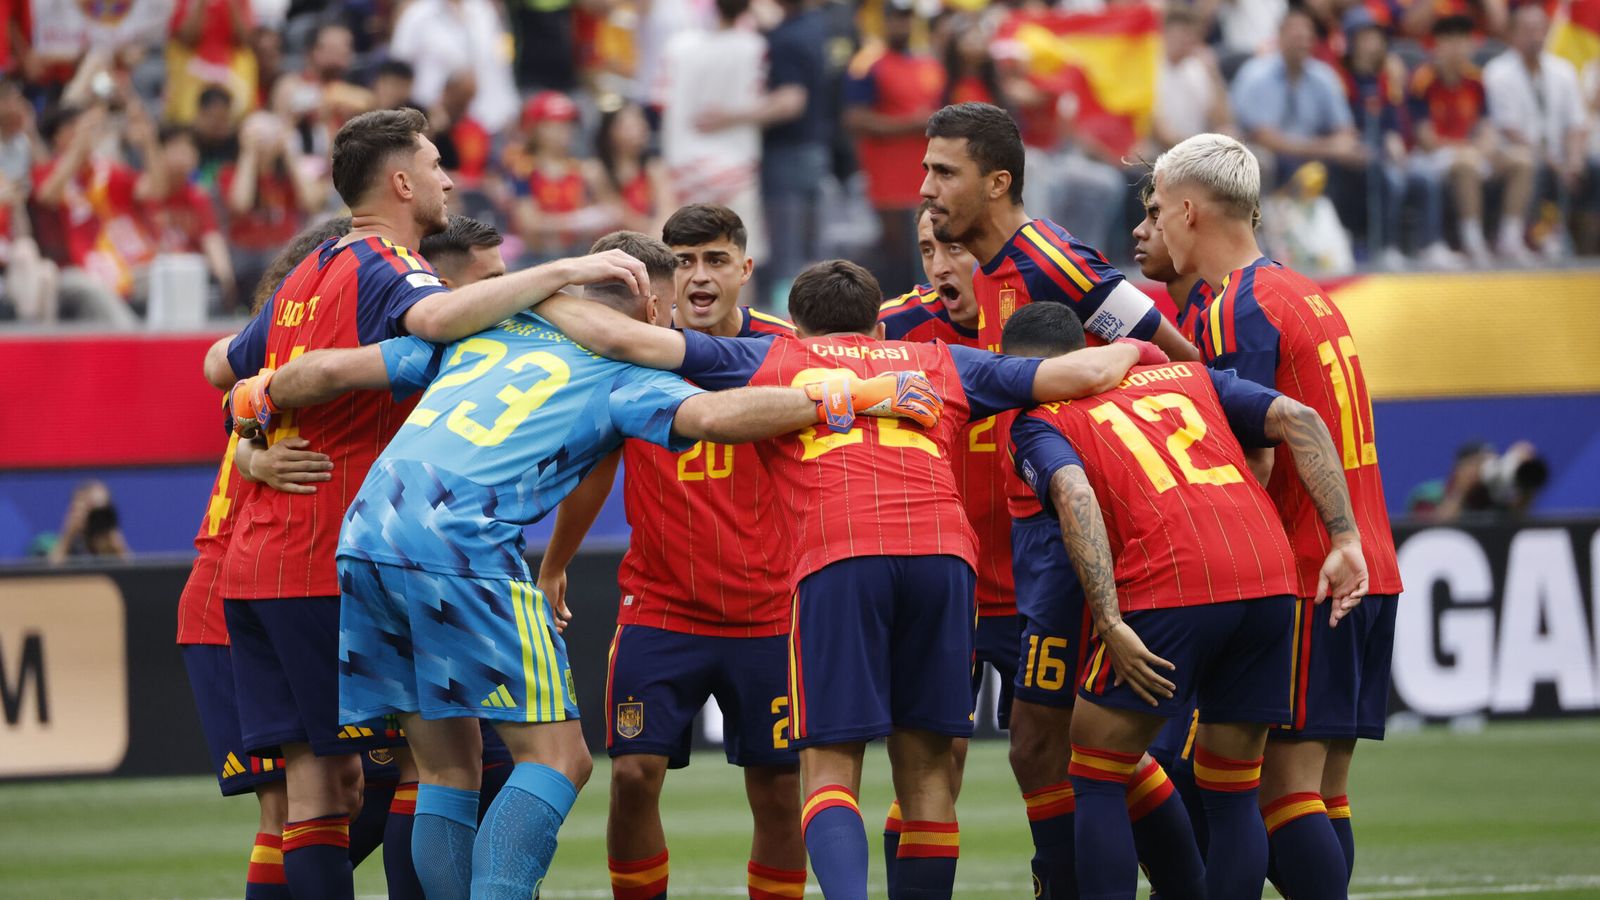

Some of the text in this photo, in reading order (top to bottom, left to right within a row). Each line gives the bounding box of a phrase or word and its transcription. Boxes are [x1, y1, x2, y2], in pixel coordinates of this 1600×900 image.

[400, 338, 571, 447] 23
[1088, 392, 1245, 494] 12
[1317, 335, 1378, 471] 10
[677, 439, 733, 481] 20
[1024, 634, 1068, 691] 16
[1391, 527, 1600, 717] GA
